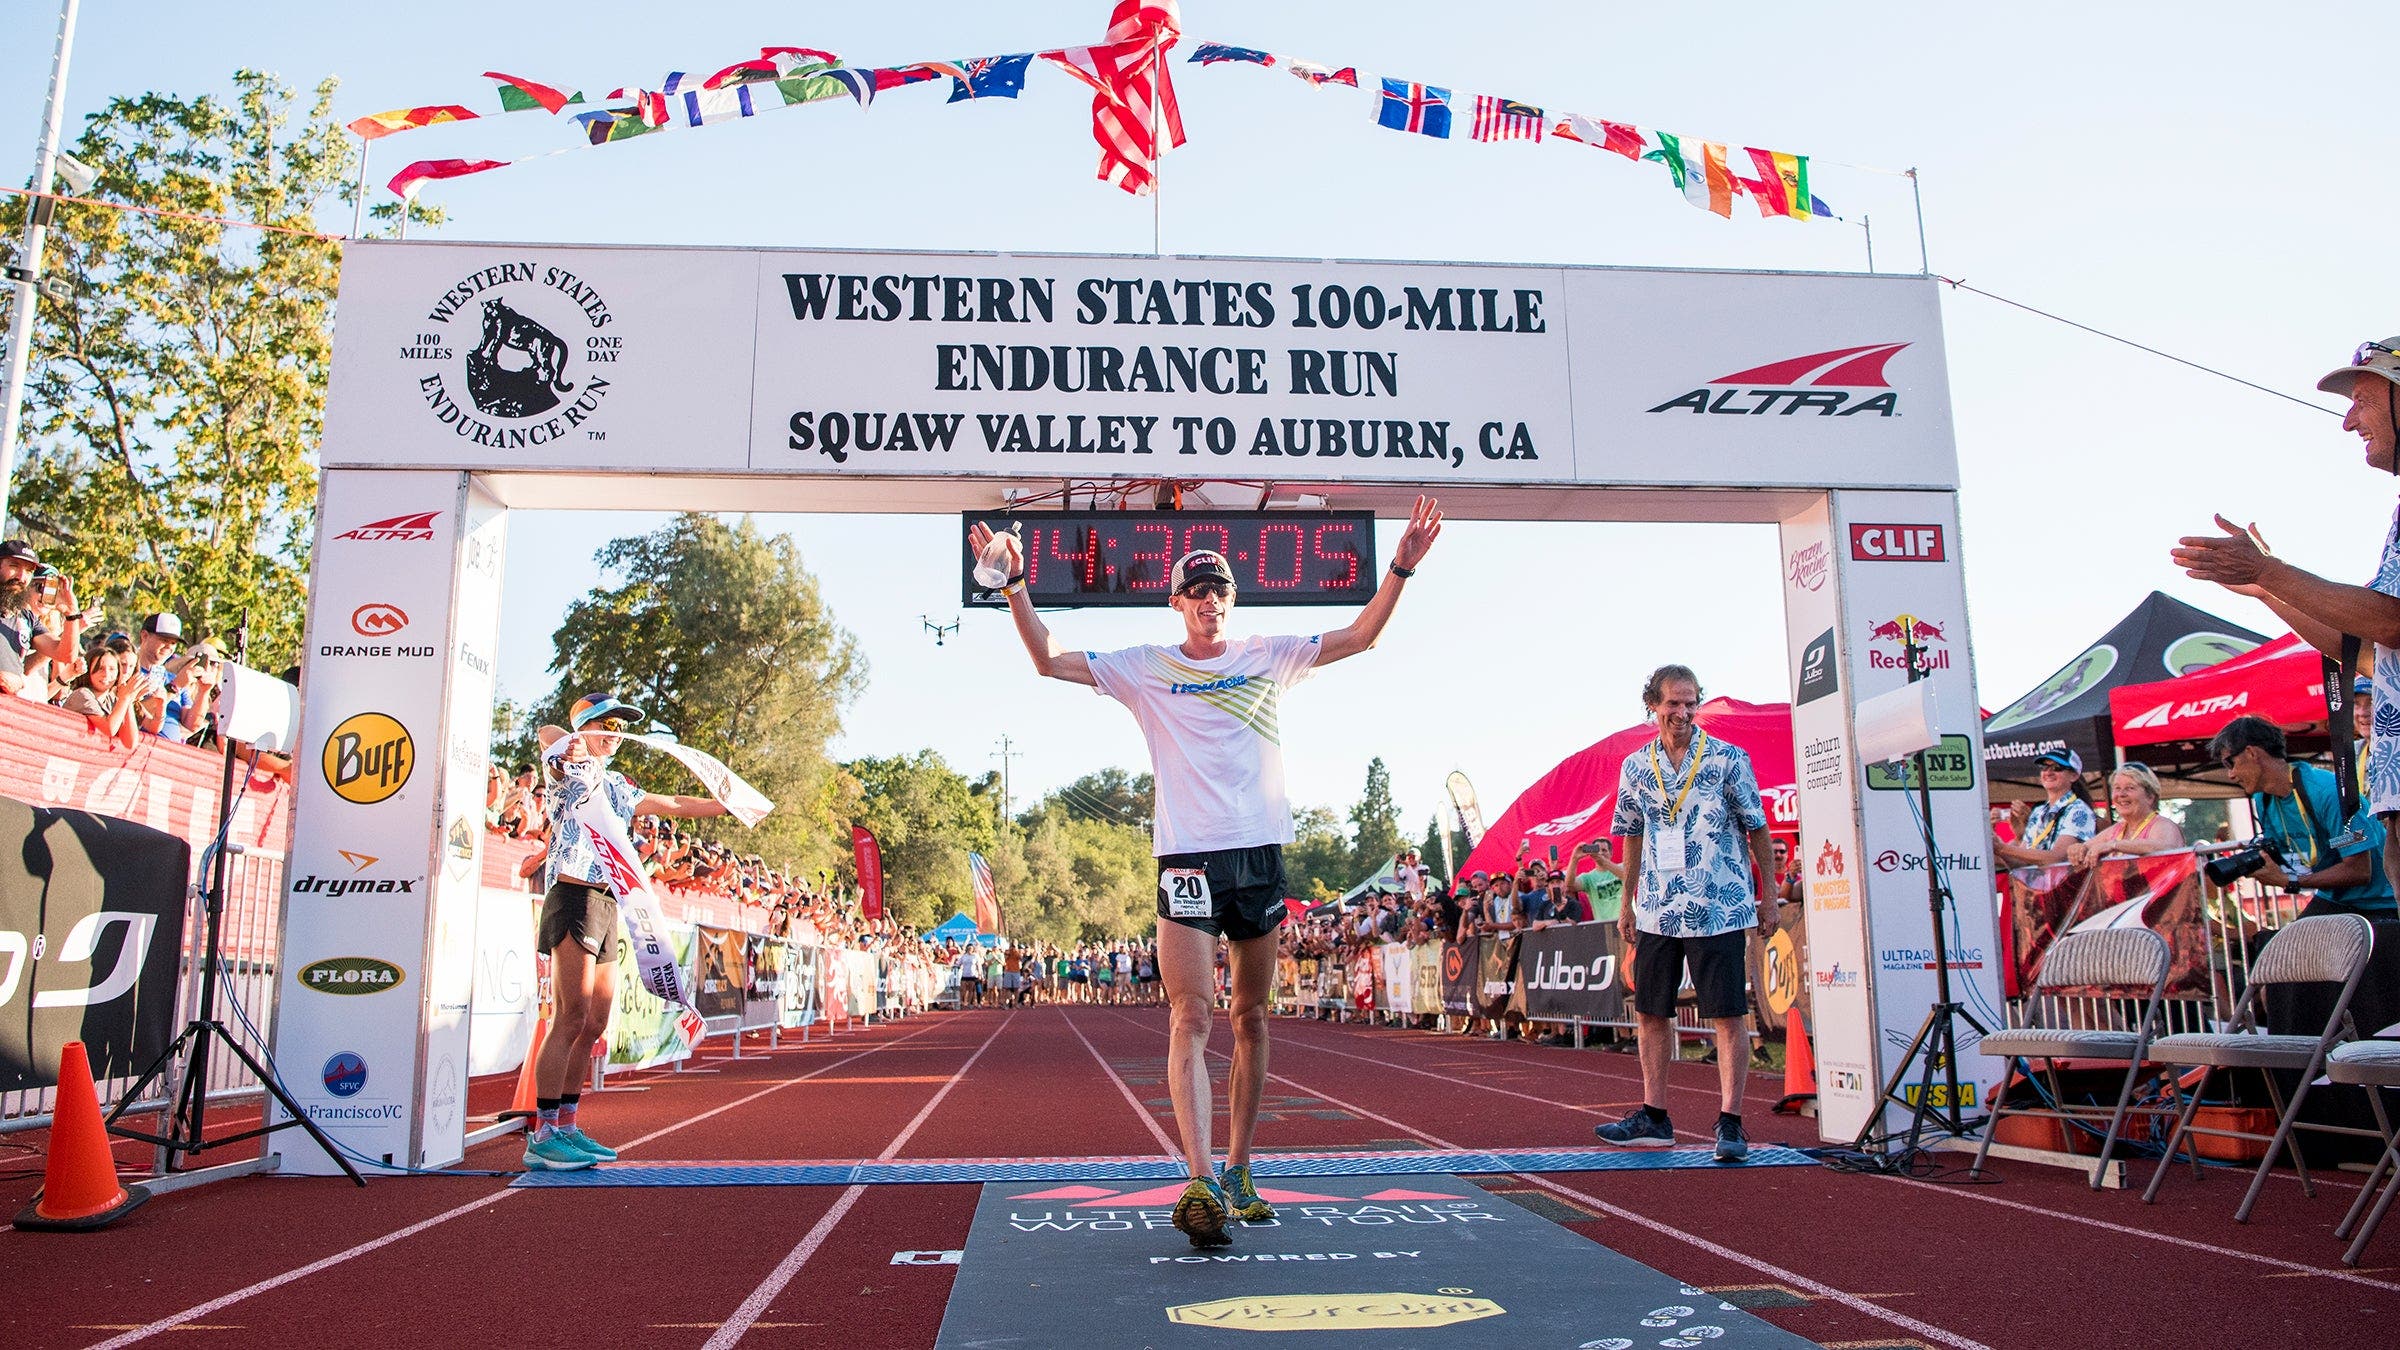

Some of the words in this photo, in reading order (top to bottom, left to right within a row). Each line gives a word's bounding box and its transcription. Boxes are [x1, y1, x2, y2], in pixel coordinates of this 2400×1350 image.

[428, 262, 538, 325] WESTERN
[543, 266, 613, 329] STATES
[782, 273, 1056, 323] WESTERN
[1077, 276, 1276, 329] STATES
[1291, 283, 1546, 334] 100-MILE
[414, 333, 441, 346] 100
[586, 336, 623, 349] ONE
[399, 347, 453, 360] MILES
[587, 350, 621, 363] DAY
[935, 344, 1268, 395] ENDURANCE
[1287, 348, 1399, 398] RUN
[419, 372, 566, 449] ENDURANCE
[561, 374, 612, 429] RUN
[1644, 388, 1899, 417] ALTRA
[588, 431, 606, 441] TM
[788, 410, 965, 464] SQUAW
[976, 413, 1159, 454] VALLEY
[1172, 416, 1237, 456] TO
[1248, 417, 1465, 470] AUBURN,
[1478, 421, 1539, 461] CA
[331, 529, 434, 541] ALTRA
[1860, 529, 1936, 557] CLIF
[320, 645, 392, 657] ORANGE
[397, 646, 435, 657] MUD
[1869, 649, 1909, 669] Red
[1916, 649, 1950, 670] Bull
[2171, 691, 2249, 720] ALTRA
[1804, 736, 1841, 759] auburn
[333, 732, 407, 788] Buff
[1806, 754, 1842, 775] running
[1806, 772, 1843, 792] company
[584, 823, 630, 896] ALTRA
[292, 876, 418, 897] drymax
[1172, 876, 1203, 900] 20
[634, 907, 660, 955] 2018
[311, 969, 394, 983] FLORA
[1528, 950, 1586, 990] Julbo
[1767, 945, 1796, 999] Buff
[339, 1081, 360, 1091] SFVC
[1905, 1083, 1976, 1107] VSA
[280, 1104, 403, 1120] SFranciscoVC
[1009, 1219, 1282, 1232] WORD
[1301, 1213, 1506, 1226] TOUR
[1149, 1252, 1358, 1264] POWERED
[1372, 1250, 1422, 1259] BY
